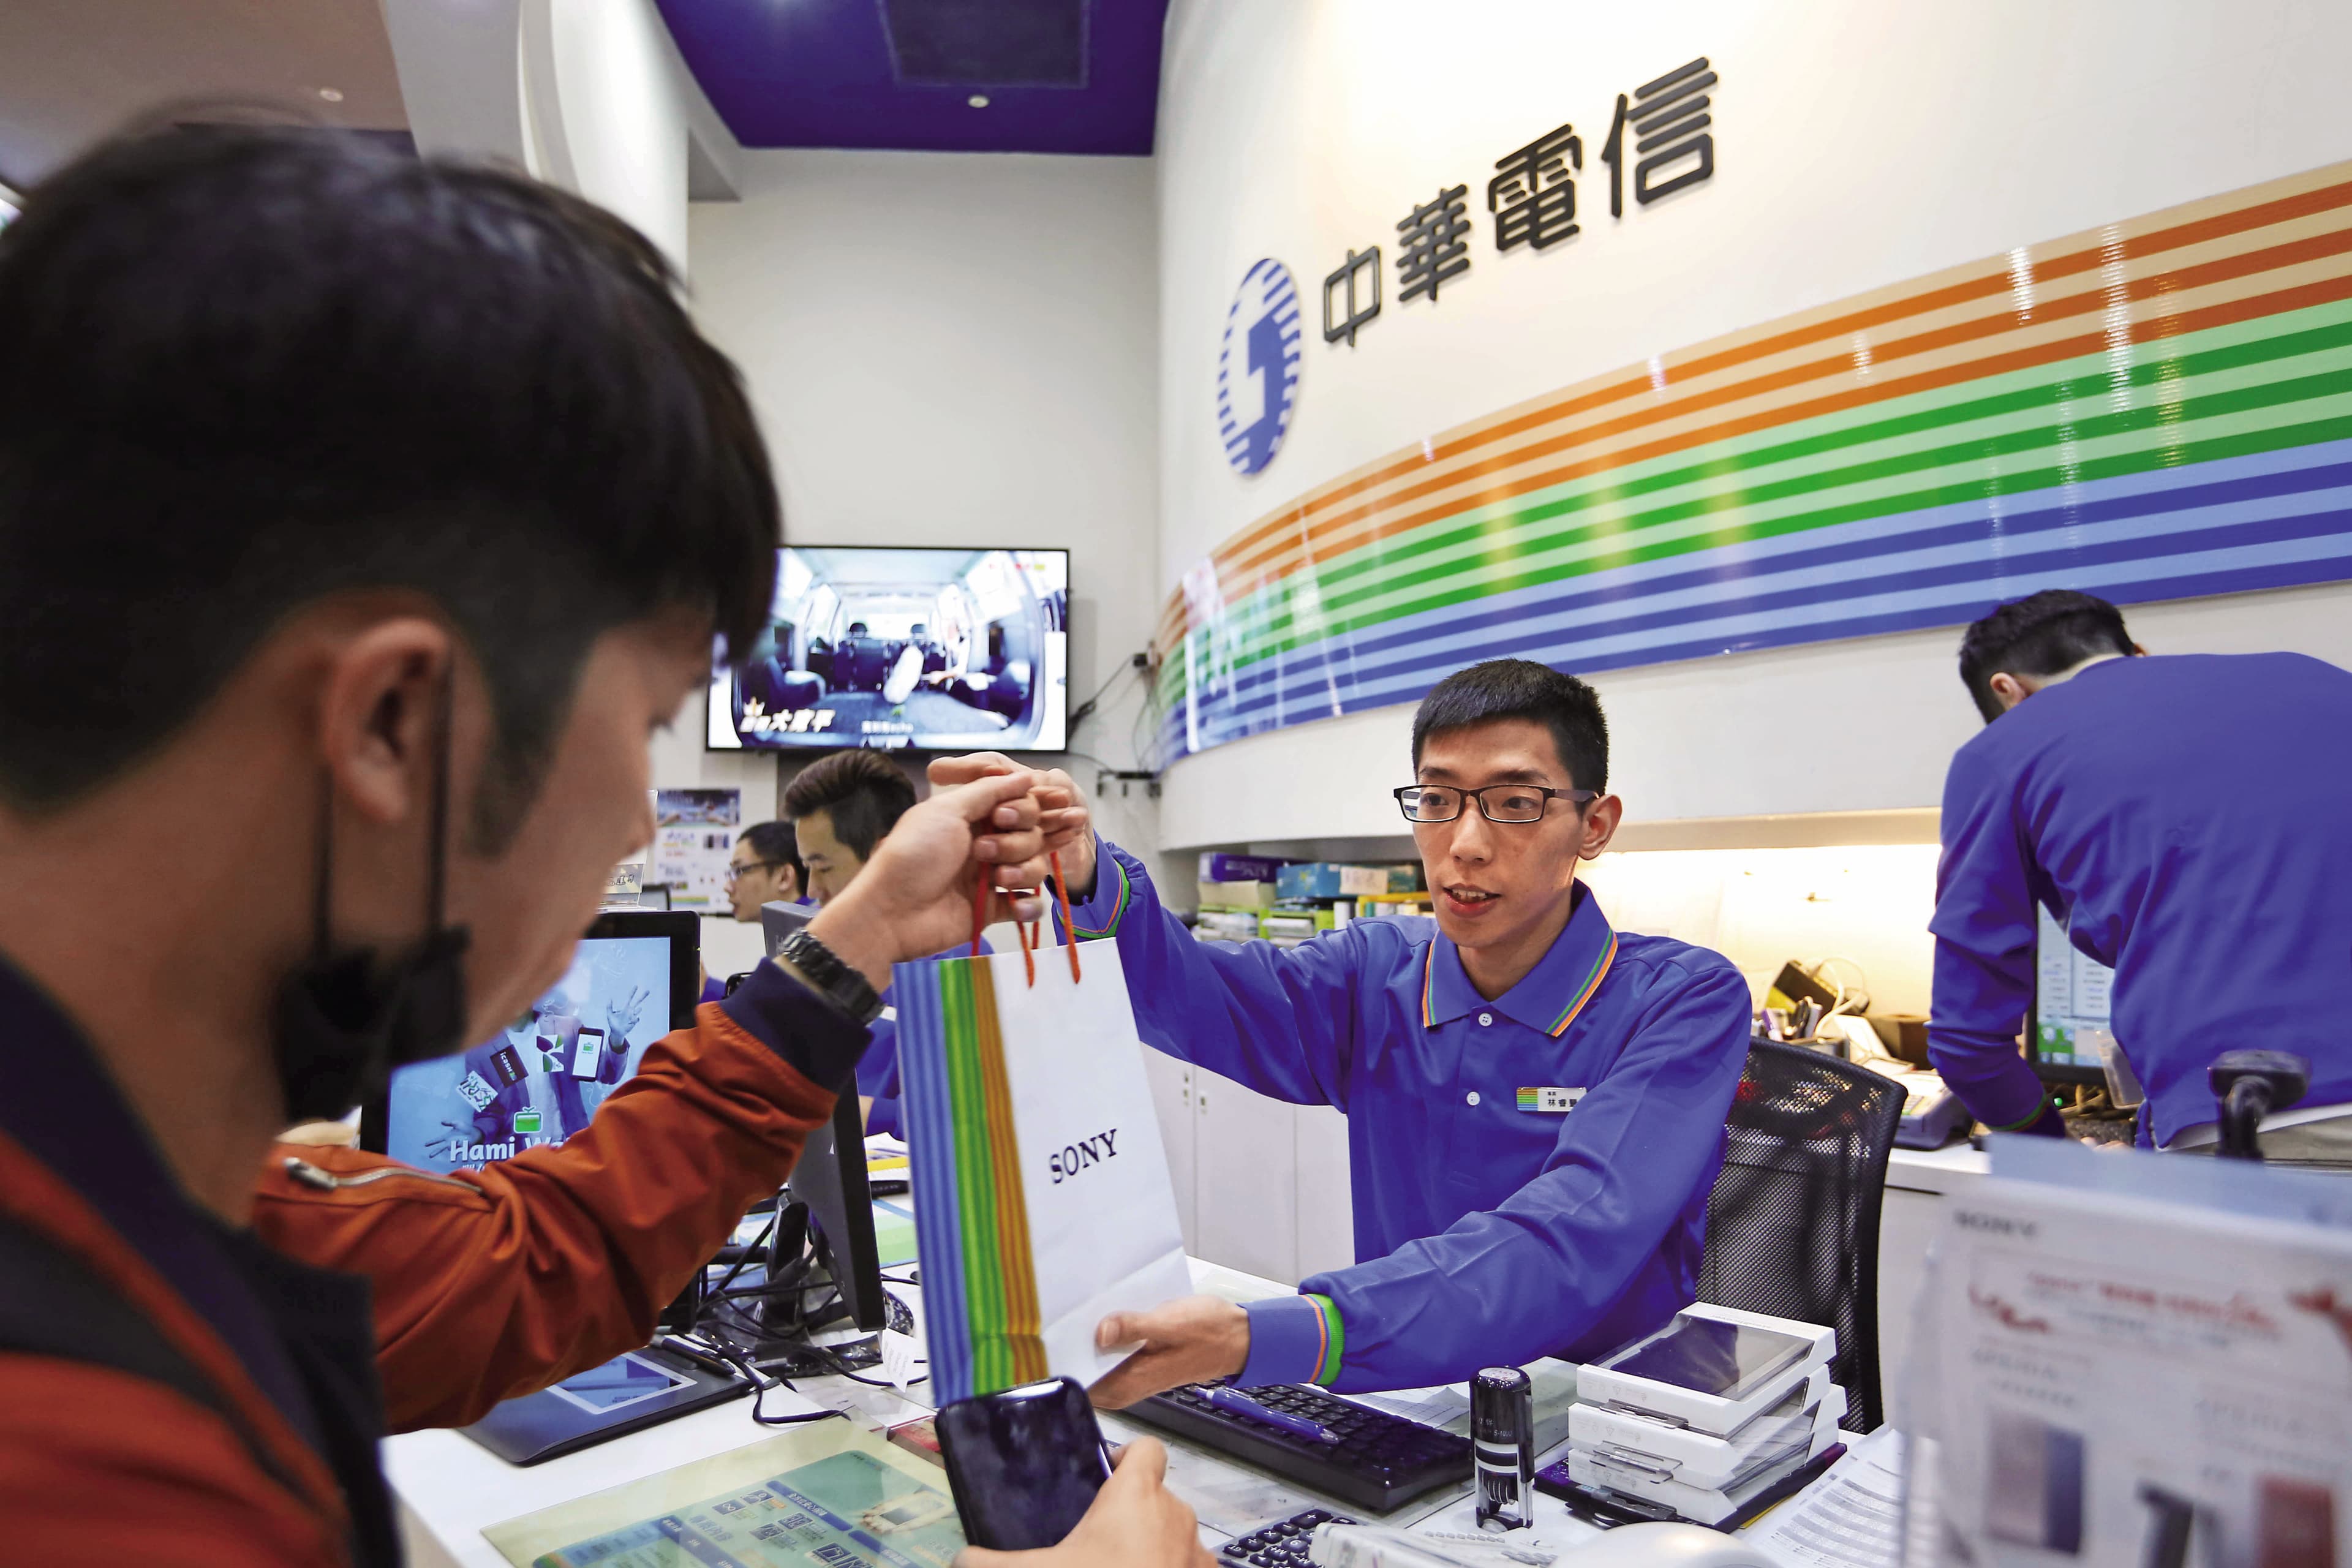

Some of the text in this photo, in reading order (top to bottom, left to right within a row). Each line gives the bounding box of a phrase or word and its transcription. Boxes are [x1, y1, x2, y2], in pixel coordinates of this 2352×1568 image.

[1322, 55, 1719, 348] 中華電信
[450, 1136, 515, 1162] Hami
[1049, 1128, 1117, 1184] SONY
